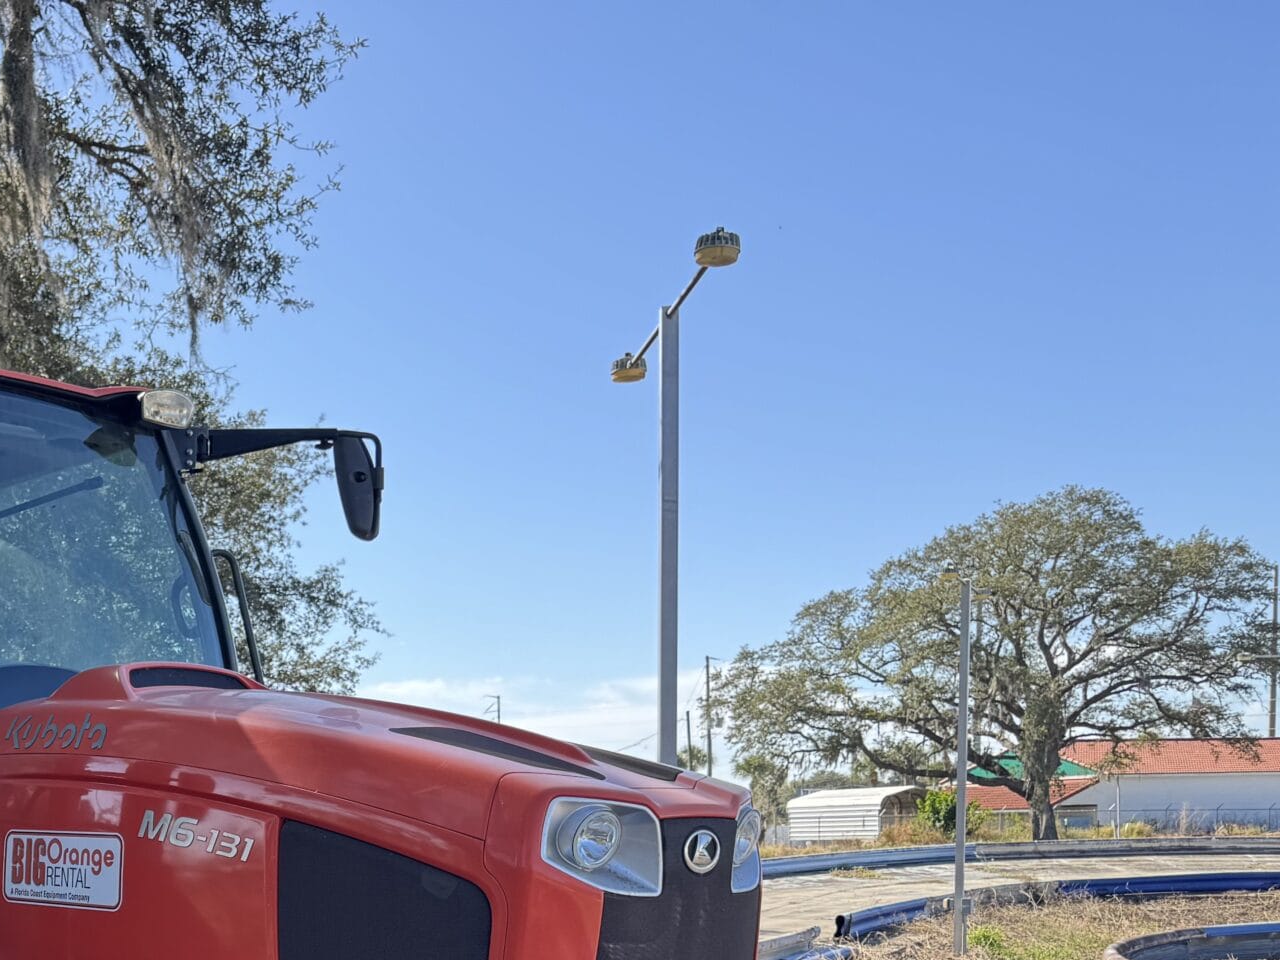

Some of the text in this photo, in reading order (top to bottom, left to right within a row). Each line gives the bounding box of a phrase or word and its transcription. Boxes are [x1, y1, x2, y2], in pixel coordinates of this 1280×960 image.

[5, 713, 107, 749] Kubota
[138, 809, 255, 862] M6-131
[11, 837, 115, 885] BIG Orange
[46, 866, 91, 889] RENTAL
[15, 888, 29, 896] Florida
[30, 889, 43, 897] Coast
[43, 890, 67, 899] Equipment
[68, 892, 90, 902] Company
